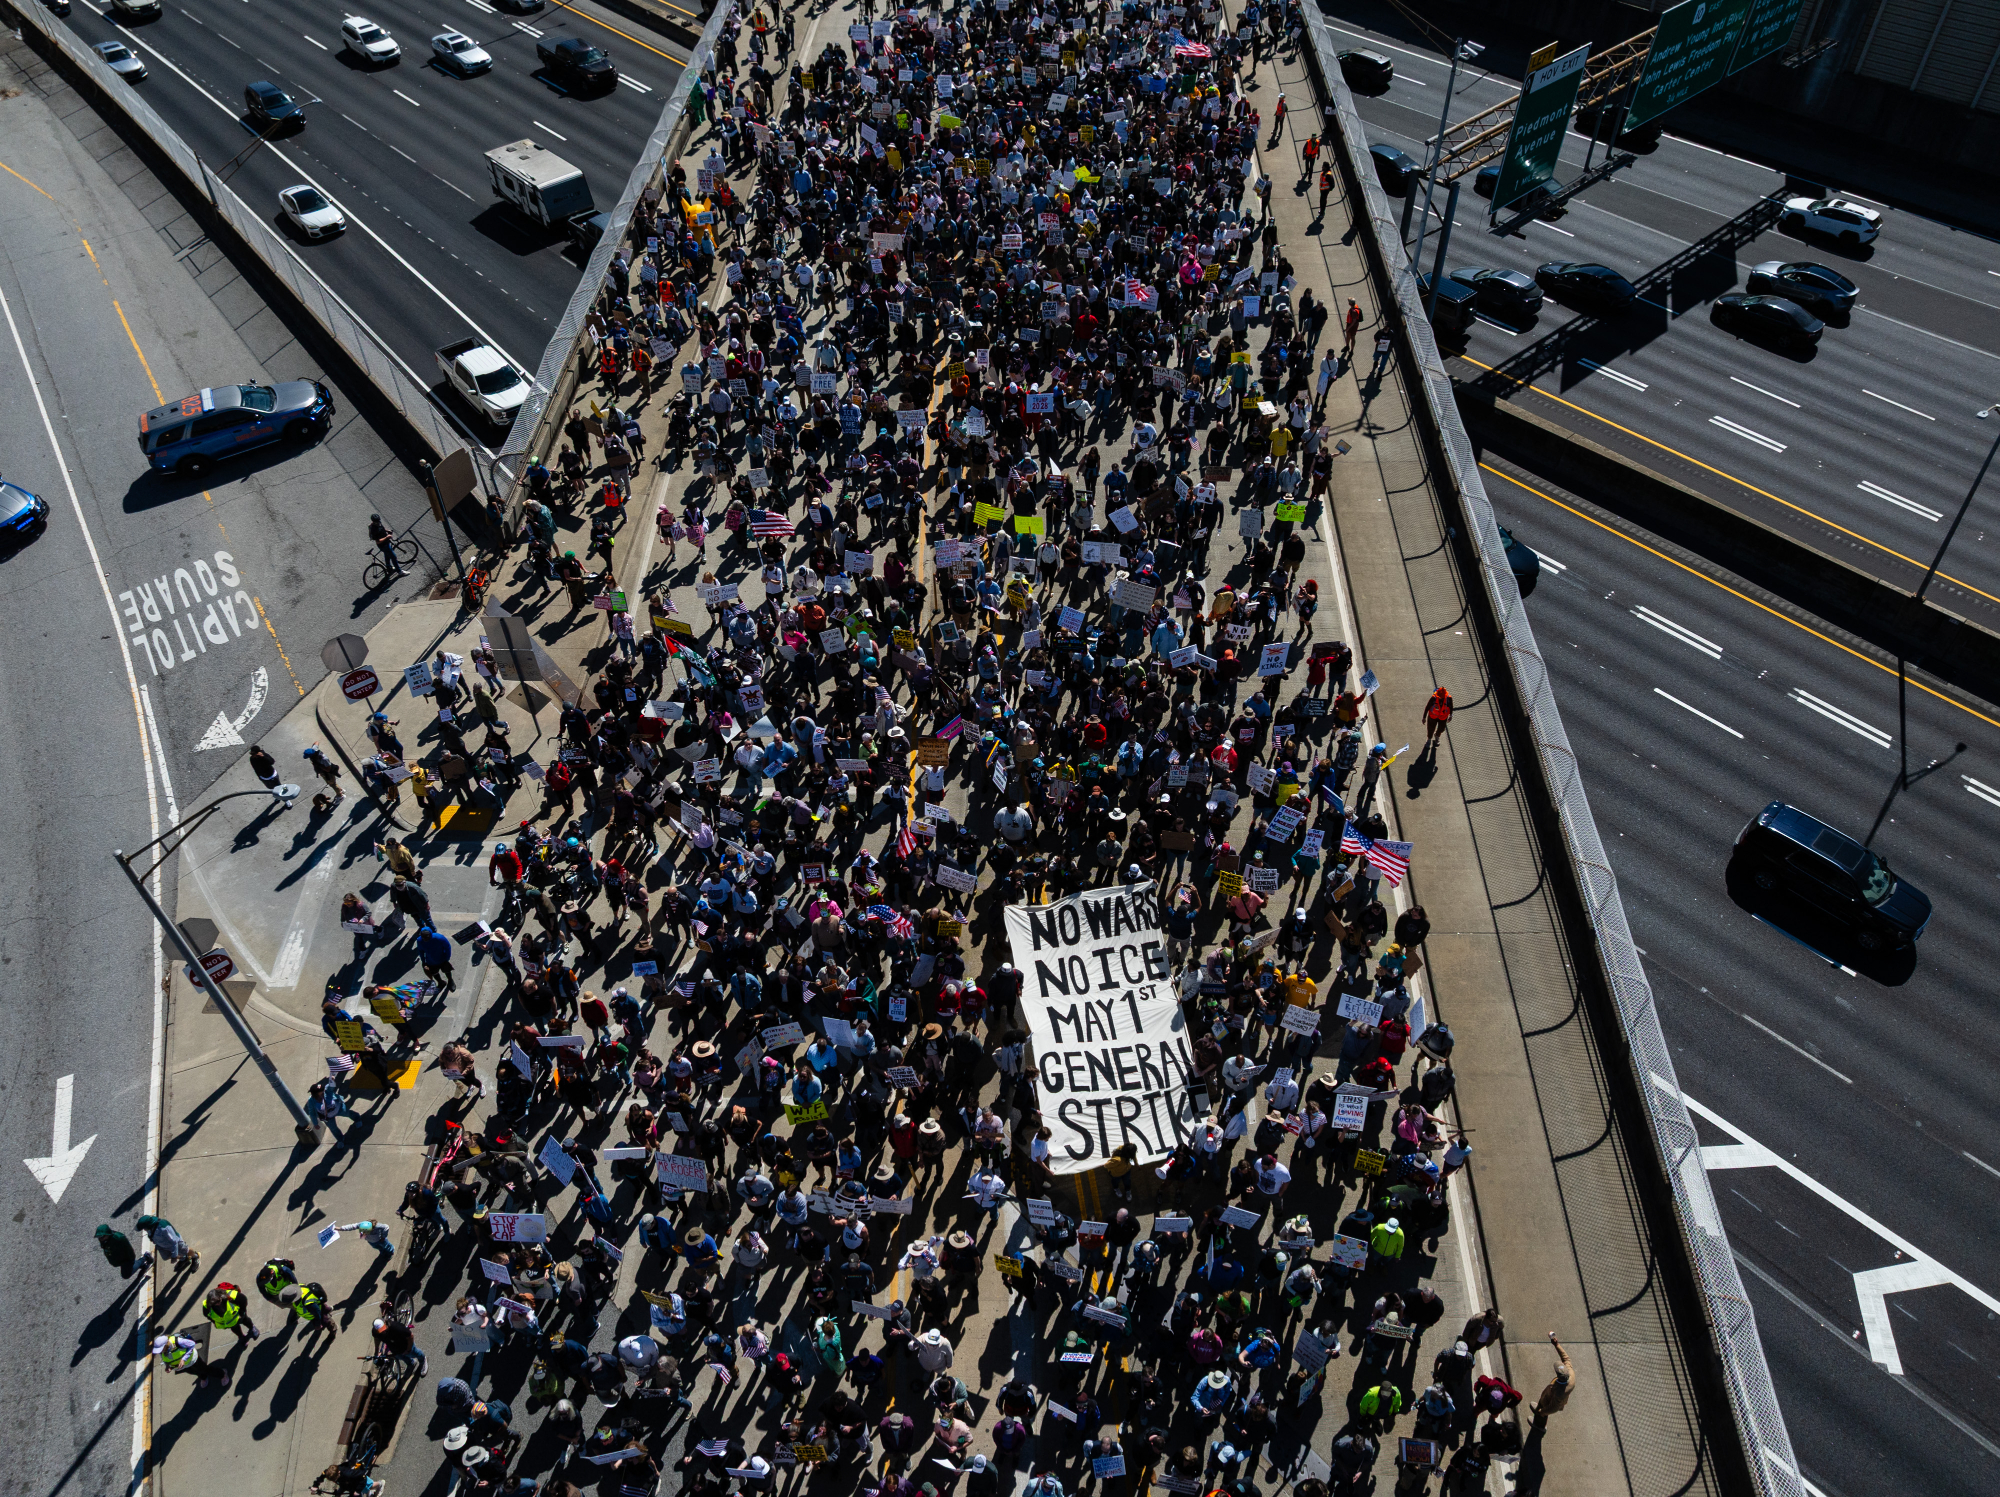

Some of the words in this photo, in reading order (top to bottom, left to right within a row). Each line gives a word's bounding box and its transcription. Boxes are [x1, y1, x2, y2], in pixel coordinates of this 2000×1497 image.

[1754, 8, 1785, 28] Auburn
[1751, 30, 1757, 41] W
[1760, 20, 1781, 39] Dobbs
[1782, 11, 1798, 26] Ave
[1650, 43, 1682, 65] Andrew
[1686, 30, 1709, 52] Young
[1727, 9, 1745, 29] Blvd
[1531, 49, 1555, 71] LEFT
[1641, 65, 1661, 88] John
[1664, 56, 1684, 77] Lewis
[1687, 40, 1720, 66] Freedom
[1539, 65, 1559, 85] HOV
[1561, 53, 1581, 74] EXIT
[1652, 75, 1680, 98] Carter
[1682, 57, 1714, 82] Center
[1515, 102, 1569, 141] Piedmont
[1515, 131, 1557, 160] Avenue
[1153, 367, 1170, 376] WHAT
[813, 381, 833, 389] FREE
[181, 394, 203, 418] 825
[1031, 402, 1049, 410] 2028
[118, 551, 241, 633] SQUARE
[707, 590, 720, 598] NO
[132, 590, 260, 676] CAPITOL
[1232, 626, 1248, 634] NO
[1226, 633, 1250, 641] WAR
[1261, 662, 1284, 671] KINGS
[344, 678, 356, 688] DO
[357, 671, 372, 683] NOT
[352, 683, 375, 699] ENTER
[421, 681, 432, 690] MAN
[1275, 811, 1297, 825] RACIST
[1220, 877, 1242, 886] KINGS
[1220, 882, 1242, 891] NO
[1029, 889, 1081, 952] NO
[1082, 887, 1160, 943] WARS
[206, 954, 223, 969] NOT
[1034, 954, 1091, 999] NO
[1092, 940, 1167, 991] ICE
[1344, 996, 1353, 1004] I
[1357, 999, 1382, 1013] STILL
[1344, 1003, 1380, 1020] BELIEVE
[1344, 1012, 1359, 1021] IN
[1046, 997, 1118, 1045] MAY
[765, 1027, 786, 1035] WINTER
[1274, 1077, 1289, 1086] ICE
[1341, 1096, 1364, 1105] THIS
[800, 1102, 823, 1116] WTF
[1337, 1108, 1364, 1118] LOVING
[1334, 1115, 1363, 1125] America
[655, 1153, 678, 1163] LIVE
[658, 1160, 671, 1171] MR
[670, 1163, 705, 1180] ROGERS
[1357, 1162, 1381, 1173] IRAN!
[492, 1215, 520, 1225] STOP
[491, 1223, 516, 1231] THE
[494, 1231, 516, 1240] CAP
[1375, 1328, 1411, 1339] DEMOCRACY
[1376, 1322, 1388, 1330] WE
[1388, 1324, 1411, 1334] CHOOSE
[456, 1336, 488, 1346] KINGS
[1104, 1467, 1123, 1477] KINGS
